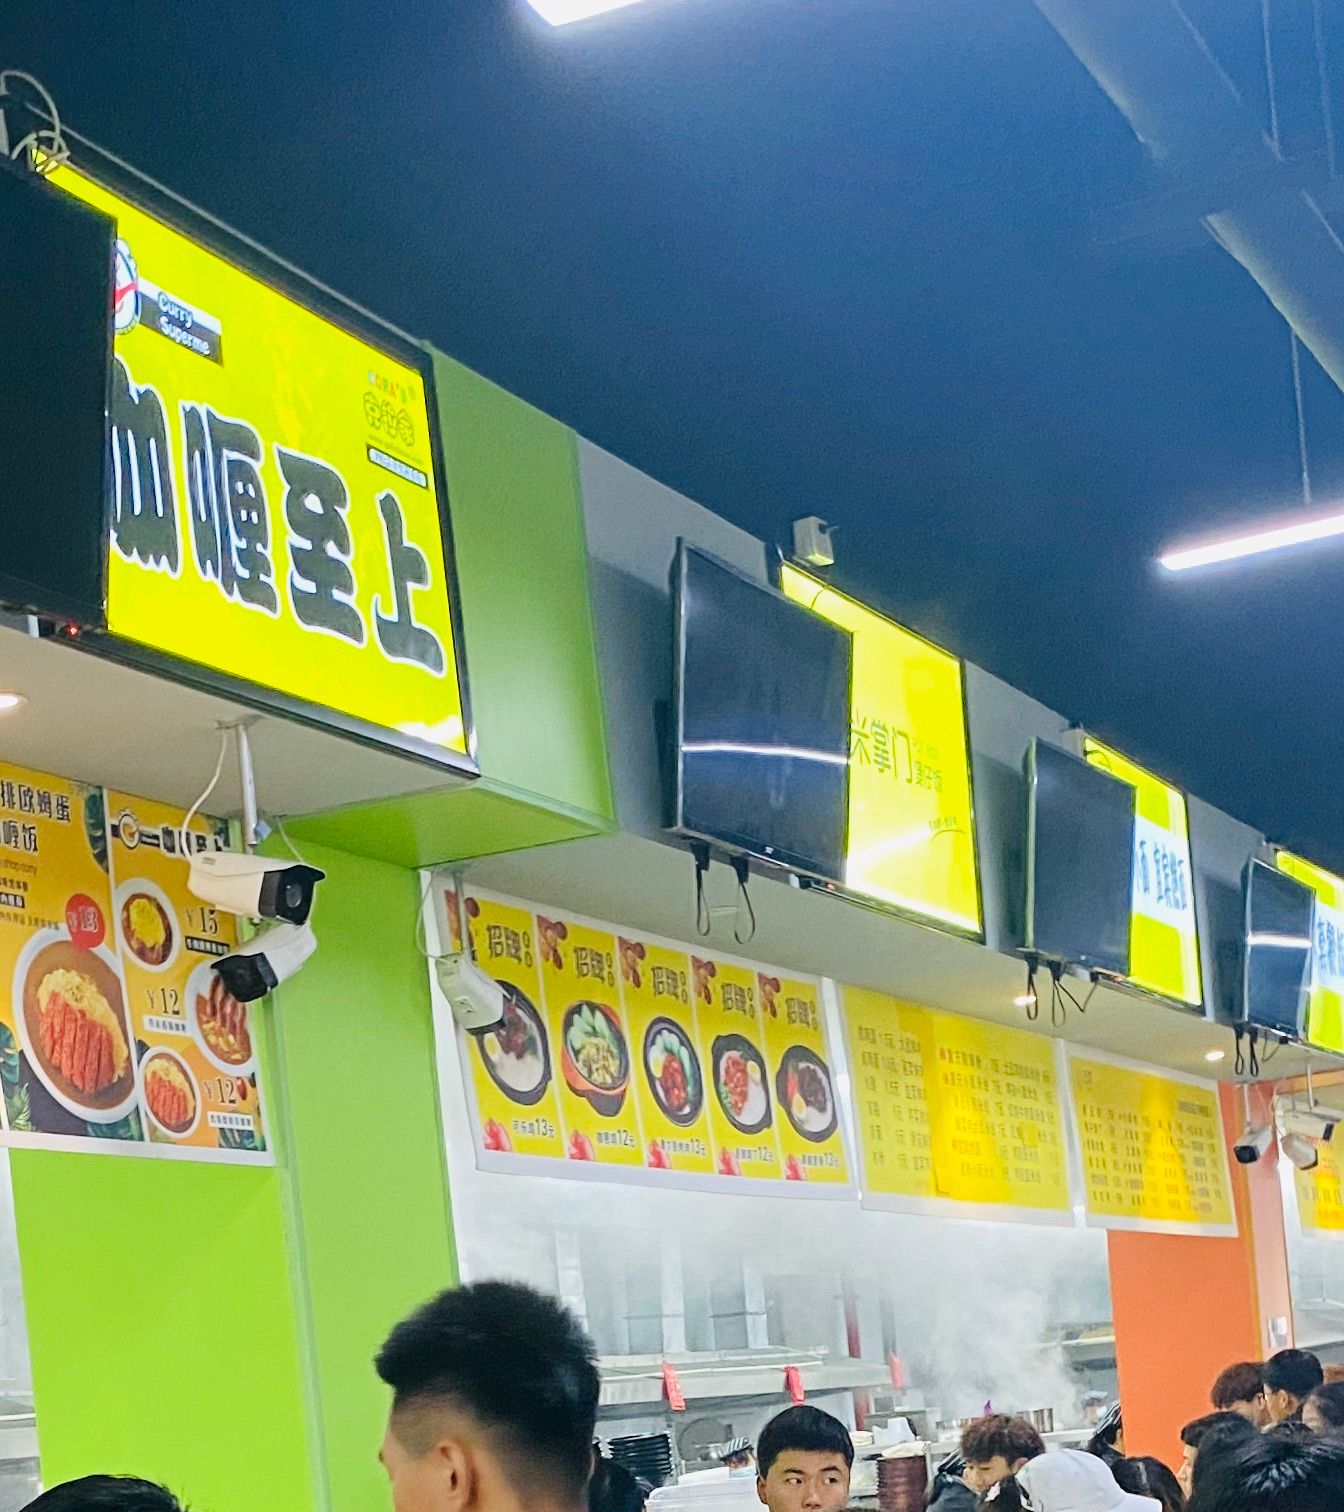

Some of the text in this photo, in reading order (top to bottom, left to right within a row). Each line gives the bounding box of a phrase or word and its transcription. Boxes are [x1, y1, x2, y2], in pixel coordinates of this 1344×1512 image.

[158, 291, 193, 328] Curry
[111, 355, 445, 675] 咖喱至上
